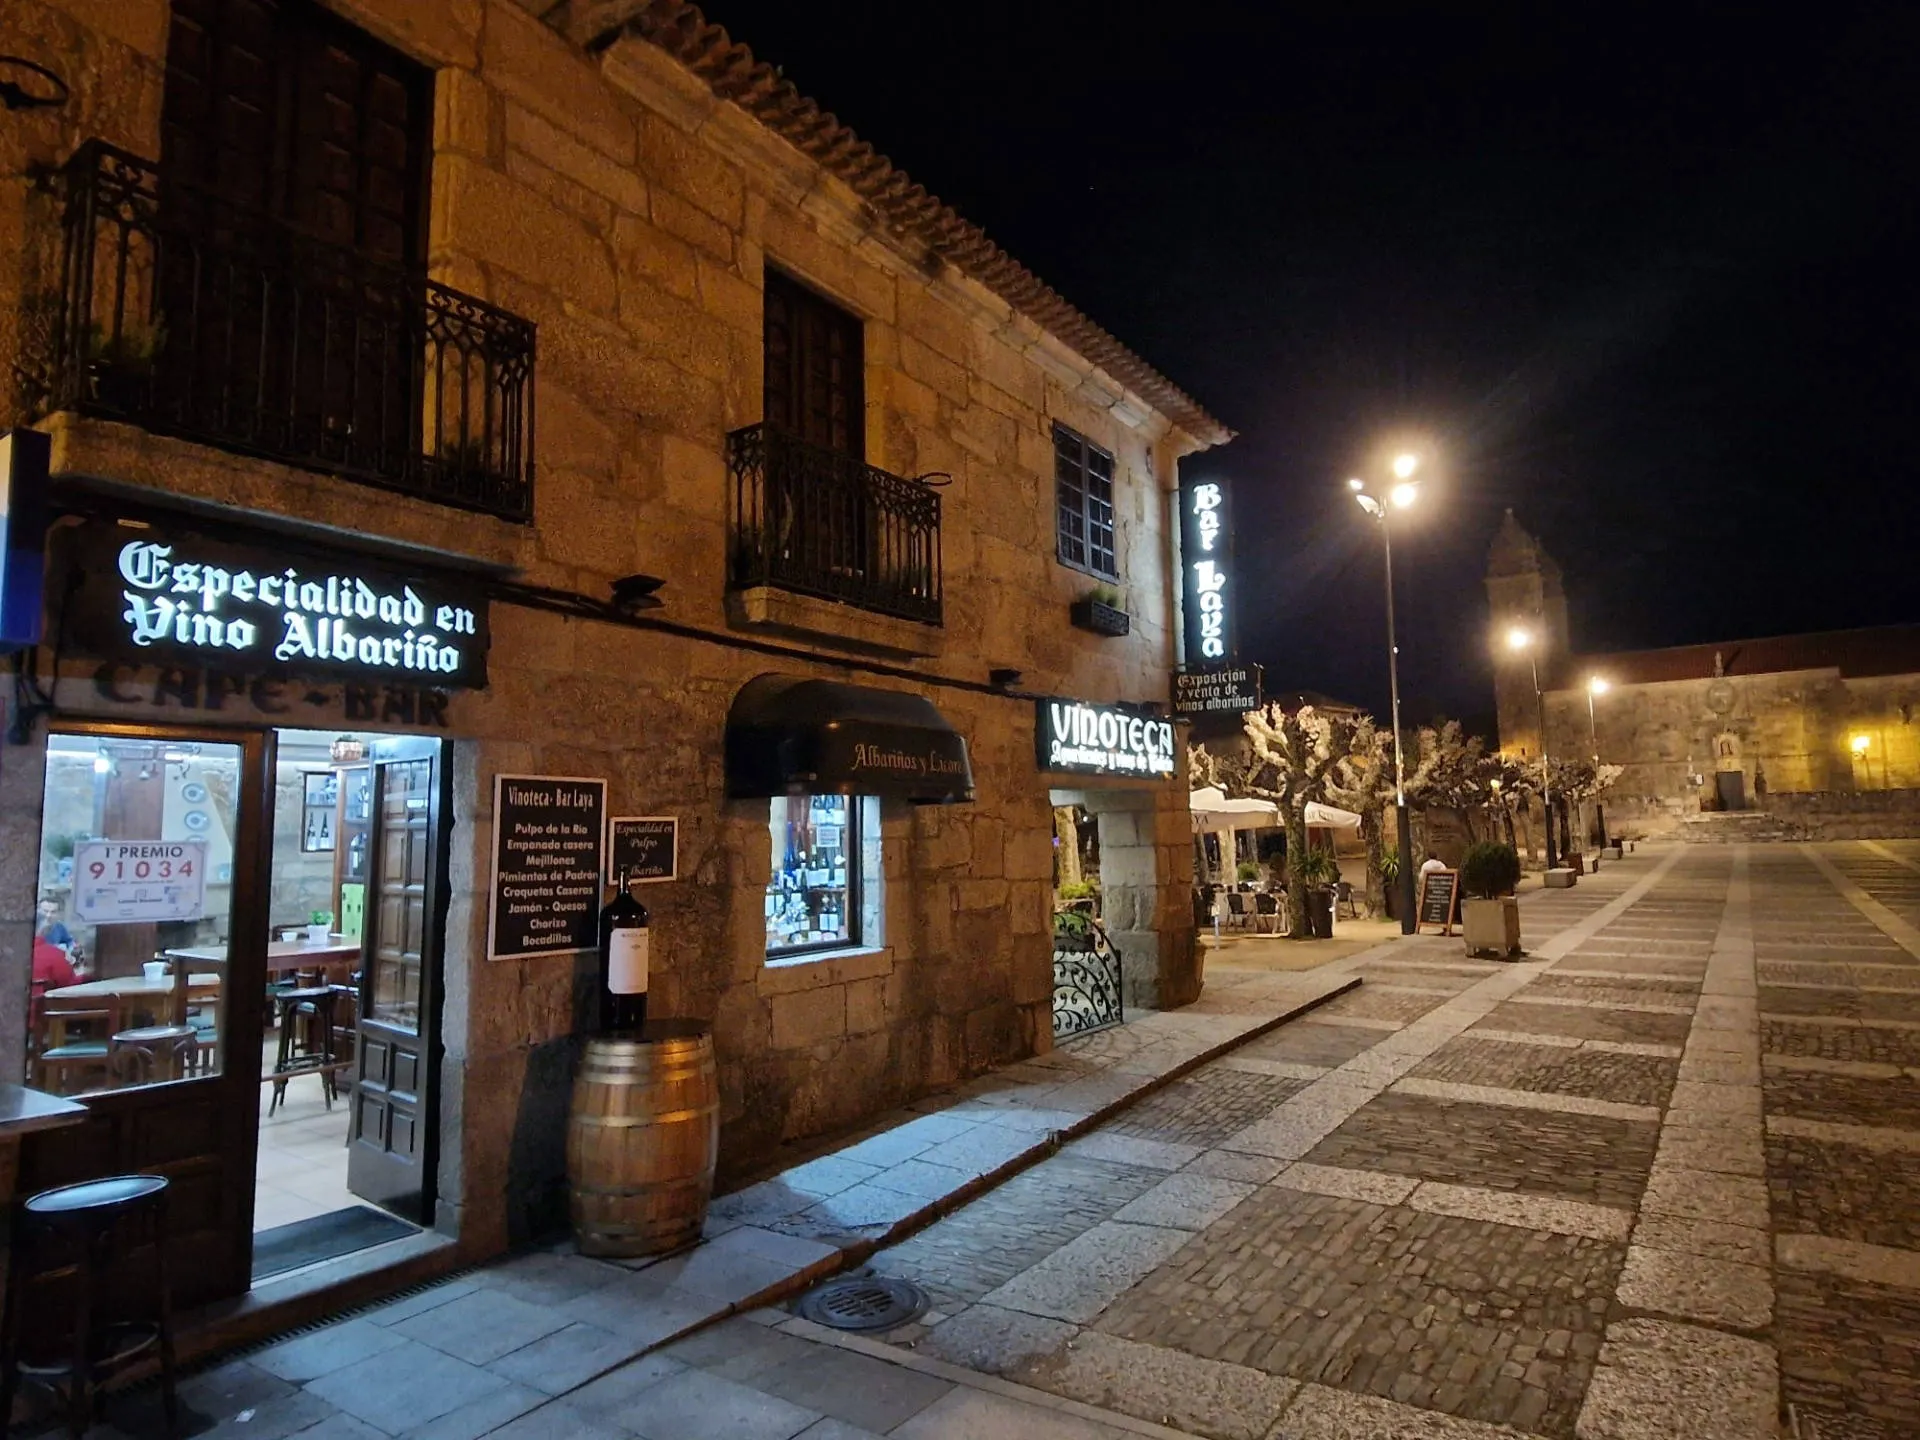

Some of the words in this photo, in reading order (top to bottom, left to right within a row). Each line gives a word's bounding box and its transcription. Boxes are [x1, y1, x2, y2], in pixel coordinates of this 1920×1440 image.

[1193, 483, 1222, 551] Bar
[118, 540, 425, 627] Especialidad
[435, 604, 476, 635] en
[1193, 560, 1226, 658] Laya
[122, 589, 257, 650] Vino
[275, 611, 461, 673] Albariño
[1177, 668, 1247, 688] Exposición
[1176, 689, 1184, 700] y
[1187, 686, 1220, 699] venta
[1224, 682, 1239, 696] de
[344, 685, 450, 727] BAR
[1175, 699, 1204, 712] vinos
[1206, 695, 1255, 711] albariños
[1050, 702, 1174, 755] VINOTECA
[851, 743, 918, 771] Albariños
[918, 757, 927, 777] y
[556, 787, 572, 808] Bar
[573, 788, 594, 812] Laya
[514, 823, 544, 837] Pulpo
[545, 822, 558, 835] de
[561, 822, 571, 834] la
[119, 845, 184, 859] PREMIO
[507, 839, 561, 852] Empanada
[562, 840, 594, 850] casera
[630, 836, 658, 851] Pulpo
[525, 854, 576, 869] Mejillones
[499, 871, 548, 883] Pimientos
[550, 870, 563, 881] de
[564, 870, 599, 881] Padrón
[503, 886, 554, 900] Croquetas
[556, 884, 594, 896] Caseras
[508, 902, 542, 914] Jamón
[552, 900, 587, 912] Quesos
[529, 918, 567, 930] Chorizo
[522, 932, 573, 946] Bocadillos
